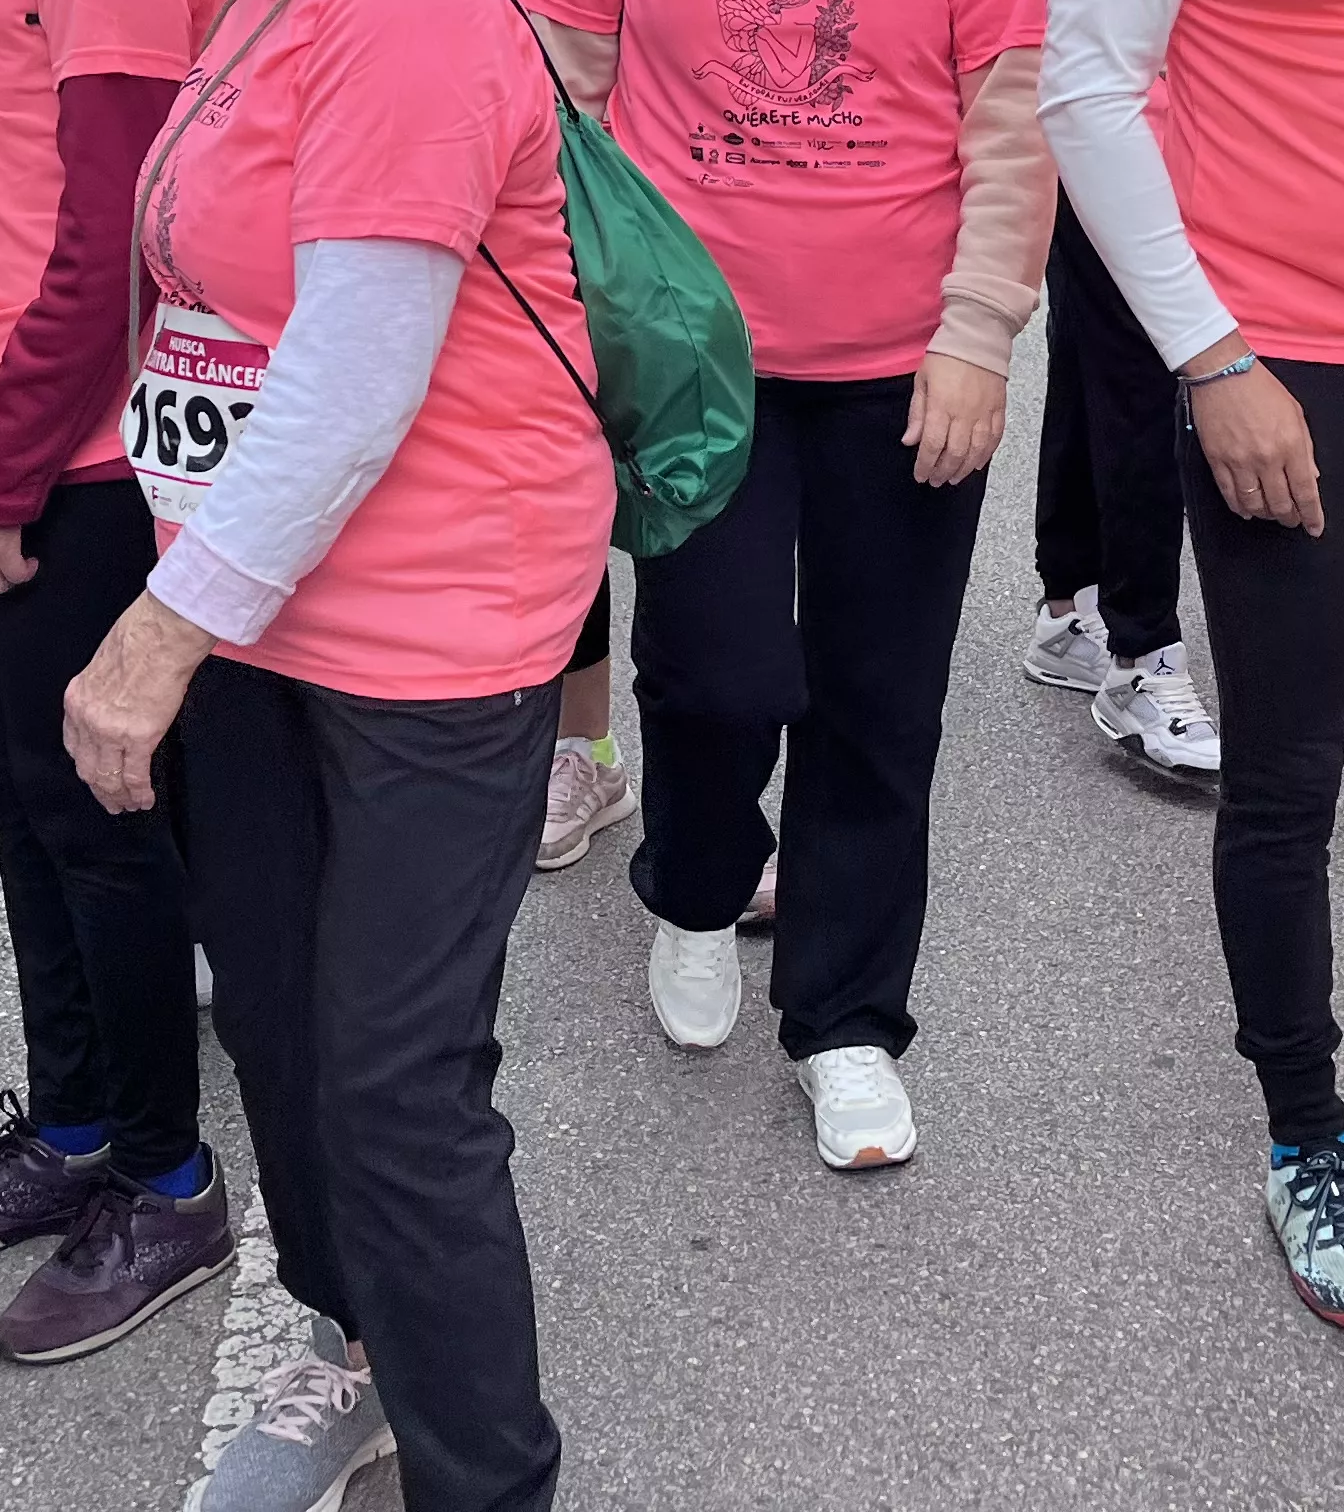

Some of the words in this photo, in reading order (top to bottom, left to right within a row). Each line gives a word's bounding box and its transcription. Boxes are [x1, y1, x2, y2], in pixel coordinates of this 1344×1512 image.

[723, 107, 802, 127] QUIÉRETE
[807, 111, 863, 128] MUCHO
[169, 335, 206, 357] HUESCA
[177, 359, 193, 378] EL
[130, 381, 255, 473] 169
